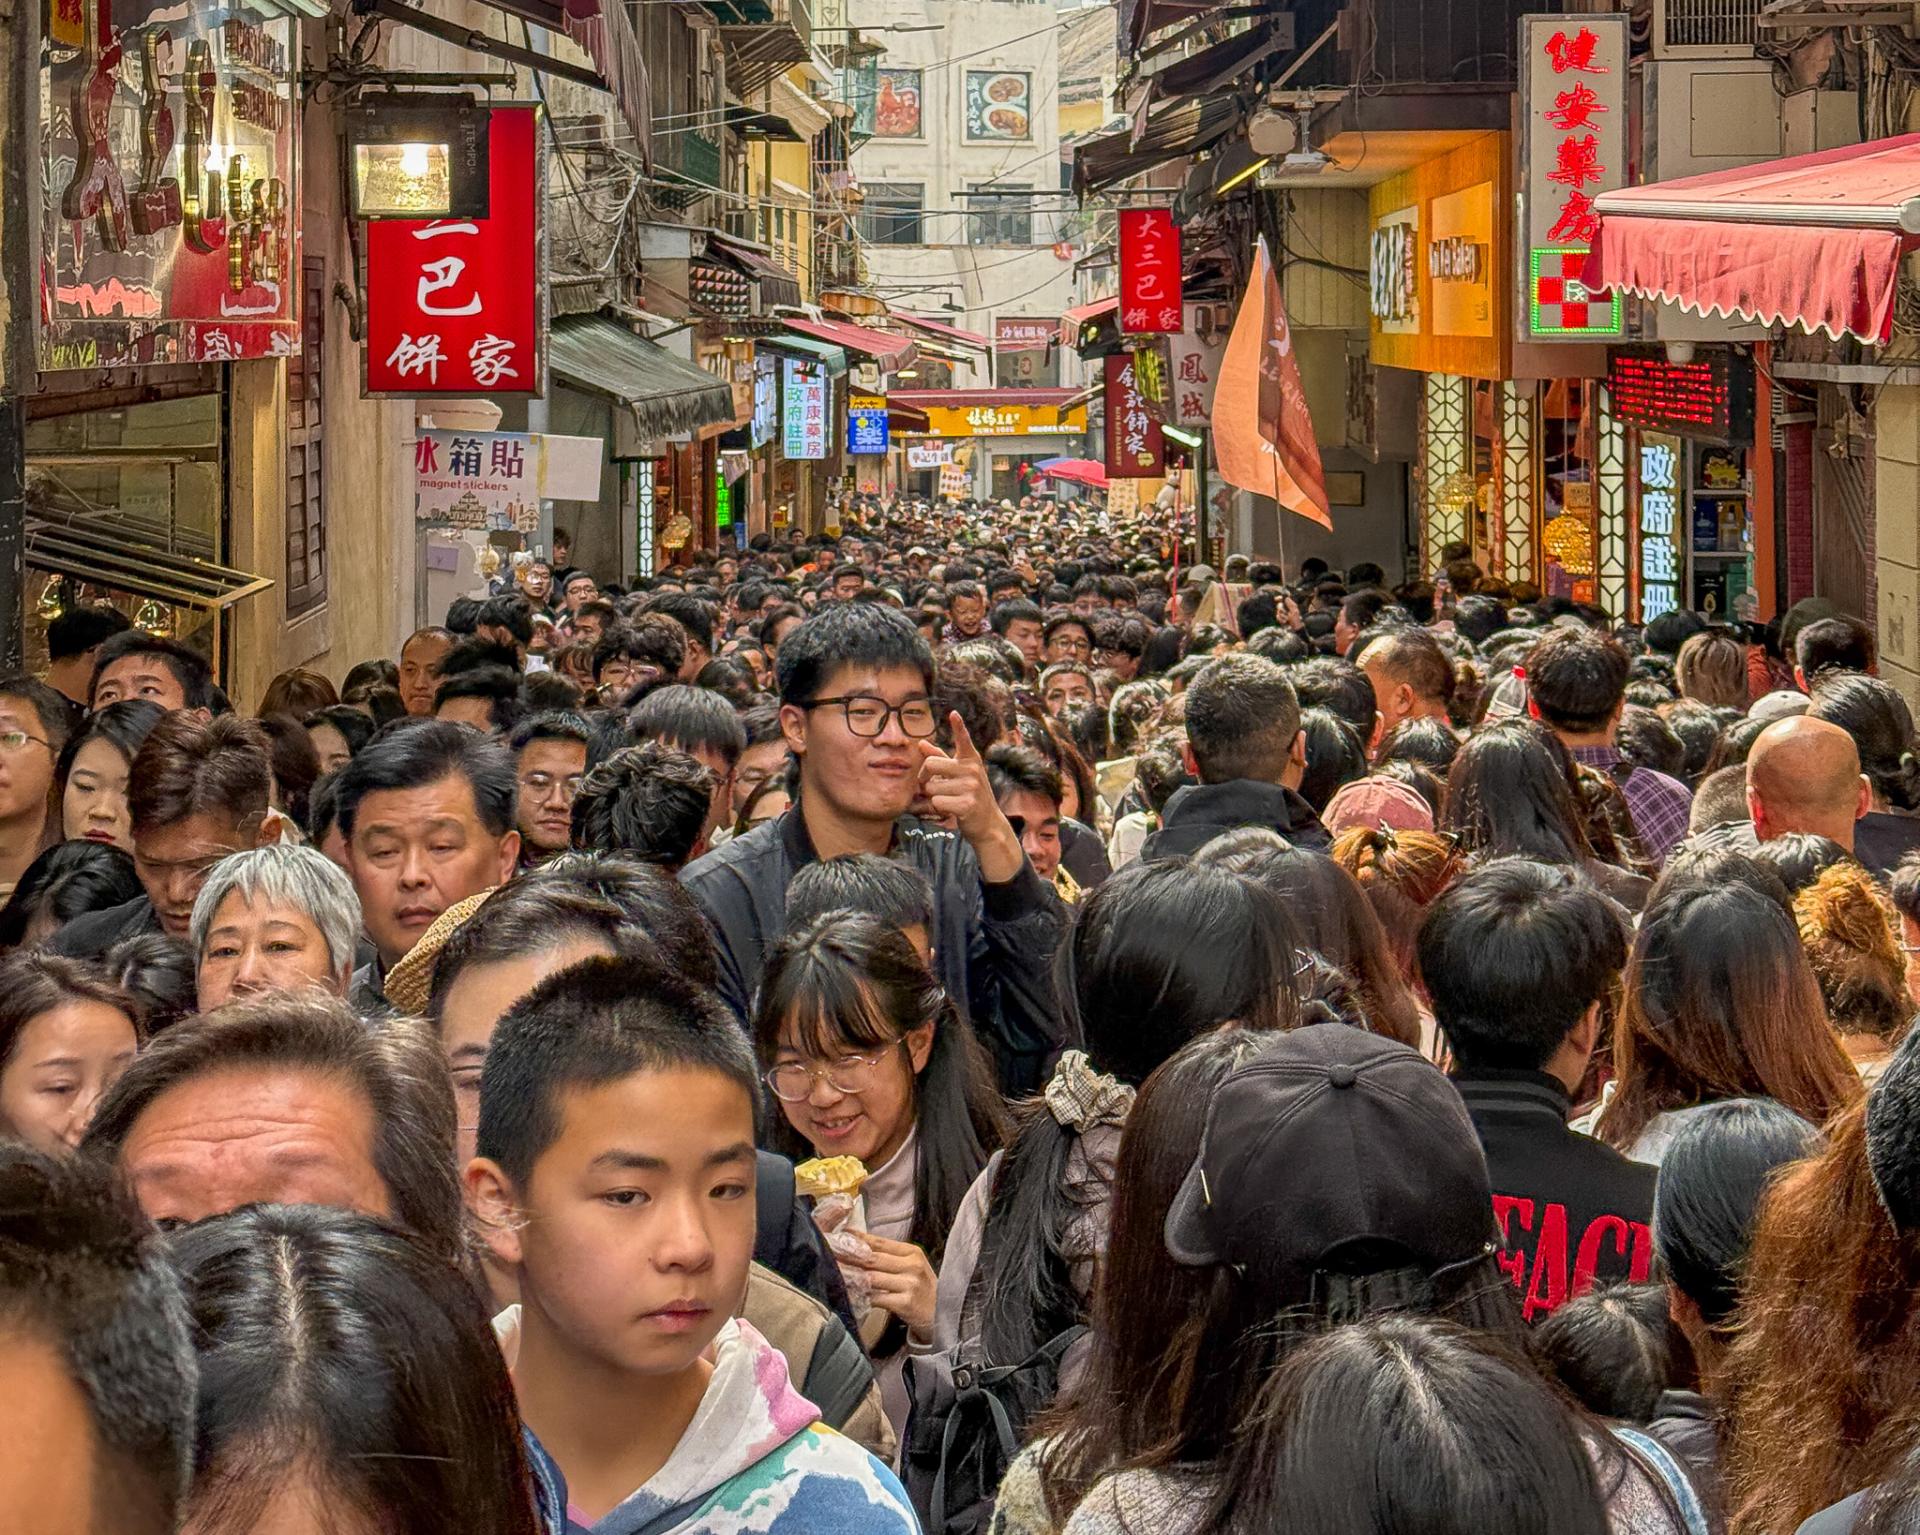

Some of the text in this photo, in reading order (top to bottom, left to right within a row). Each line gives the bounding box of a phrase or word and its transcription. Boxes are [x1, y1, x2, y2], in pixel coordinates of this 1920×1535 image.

[1134, 213, 1164, 300] 大三巴
[1124, 307, 1180, 329] 餅家
[386, 333, 519, 386] 餅家
[1178, 353, 1212, 420] 鳳城
[787, 387, 803, 457] 政府註冊
[806, 387, 821, 457] 萬康藥房
[420, 480, 508, 491] magnet stickers
[1640, 445, 1678, 624] 政府註冊
